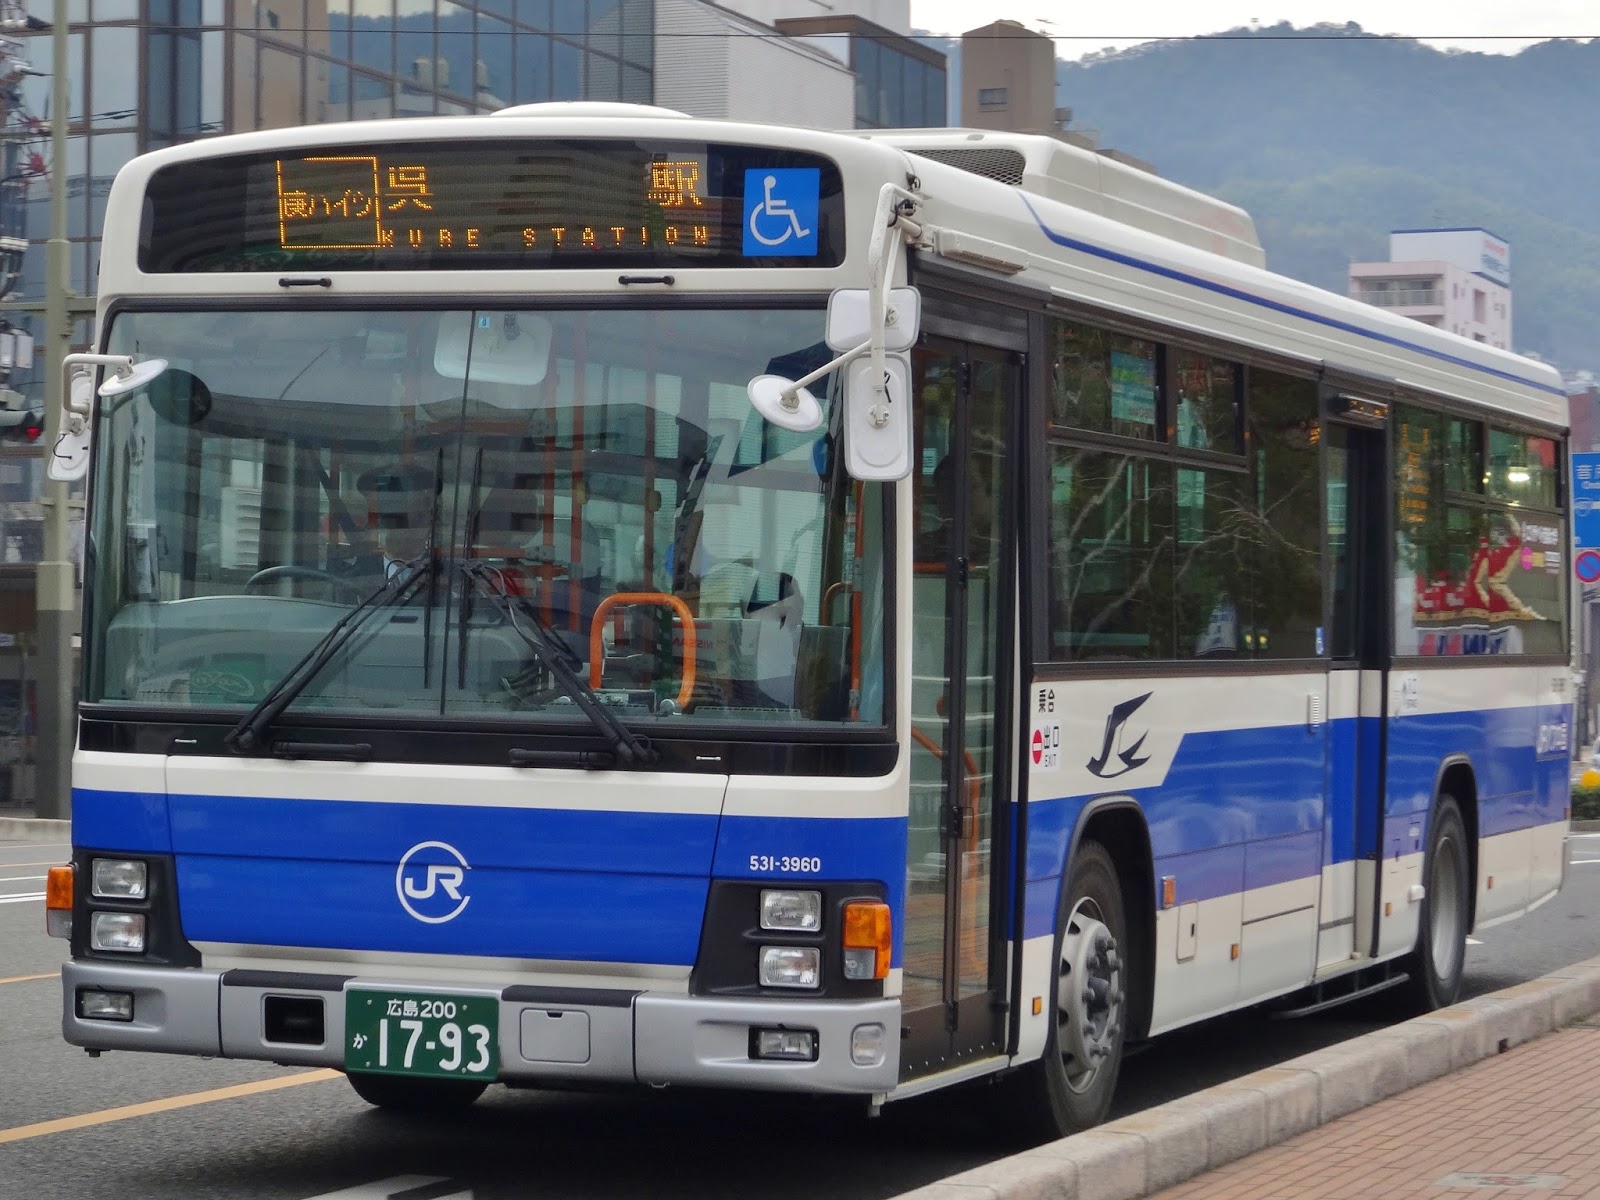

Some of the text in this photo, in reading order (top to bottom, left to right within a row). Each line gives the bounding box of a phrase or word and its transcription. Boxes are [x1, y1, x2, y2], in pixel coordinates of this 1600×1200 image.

[385, 161, 702, 210] 呉 駅
[381, 226, 706, 248] KURE STATION
[1043, 725, 1060, 750] 出口
[749, 855, 821, 873] 531-3960
[404, 865, 463, 900] JR
[352, 1018, 490, 1073] か 17-93
